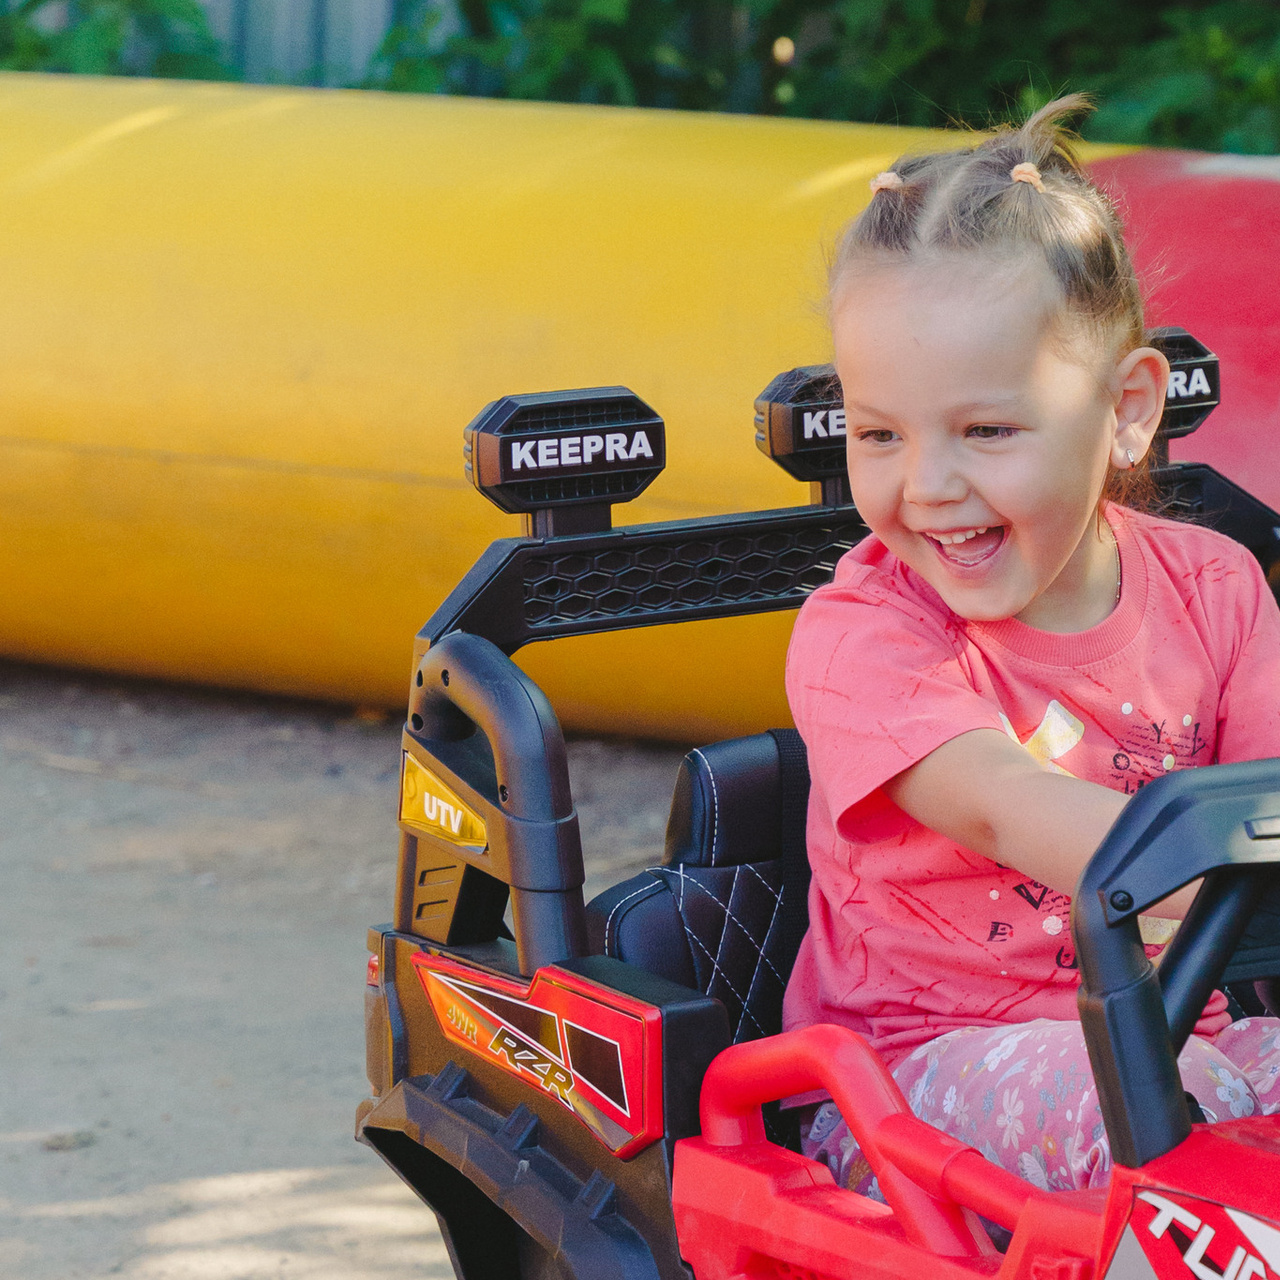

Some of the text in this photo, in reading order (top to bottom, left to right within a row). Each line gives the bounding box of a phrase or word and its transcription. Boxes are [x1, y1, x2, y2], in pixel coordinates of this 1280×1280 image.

[1167, 368, 1211, 399] RA
[803, 408, 847, 440] KE
[511, 430, 654, 471] KEEPRA
[424, 791, 463, 834] UTV
[488, 1025, 575, 1113] RZR
